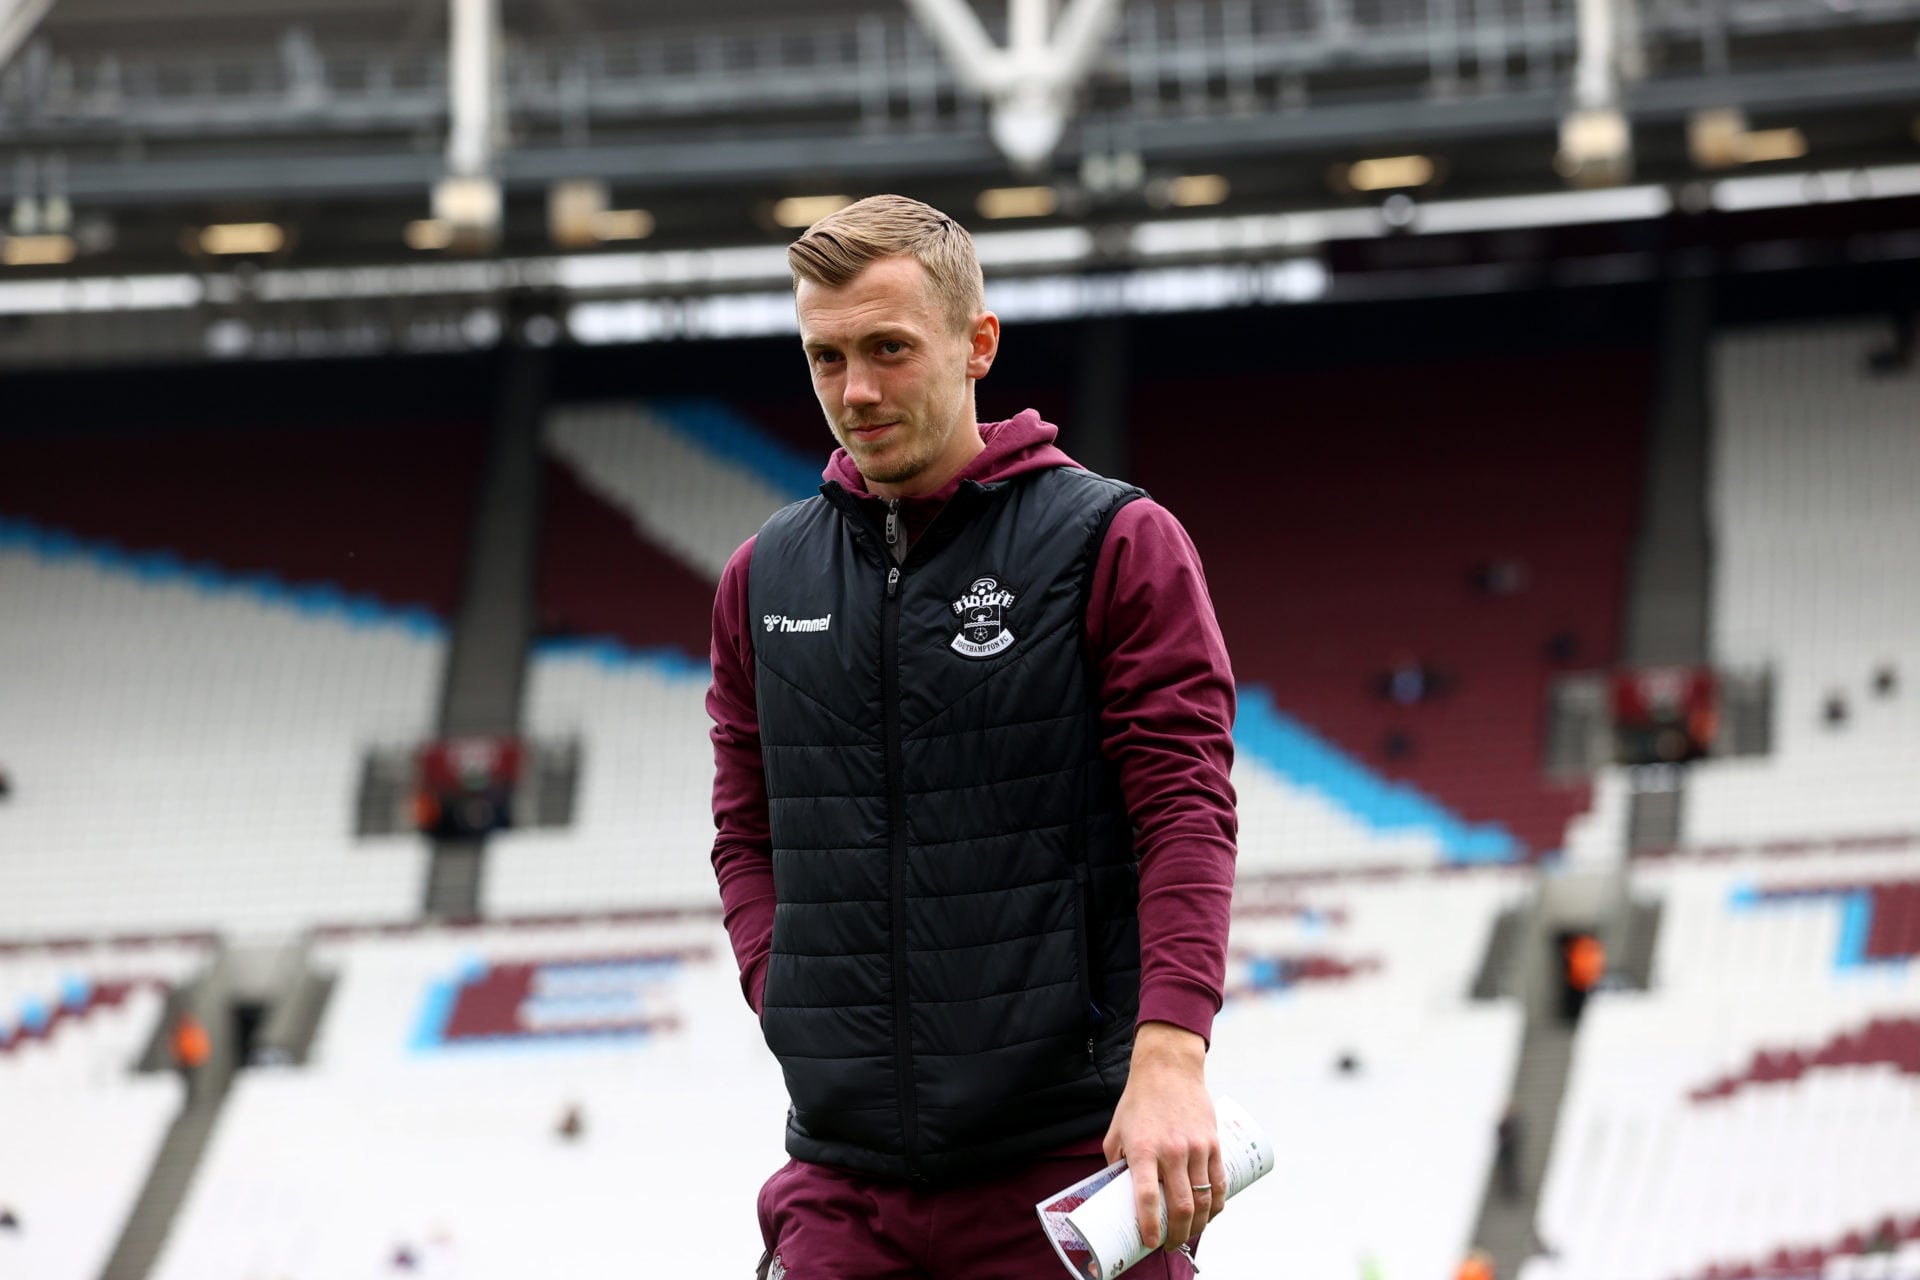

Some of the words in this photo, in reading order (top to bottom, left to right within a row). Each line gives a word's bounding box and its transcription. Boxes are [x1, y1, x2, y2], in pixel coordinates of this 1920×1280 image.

[780, 614, 831, 632] hummel
[955, 640, 1000, 652] SOUTHAMPTON
[1000, 634, 1009, 645] FC
